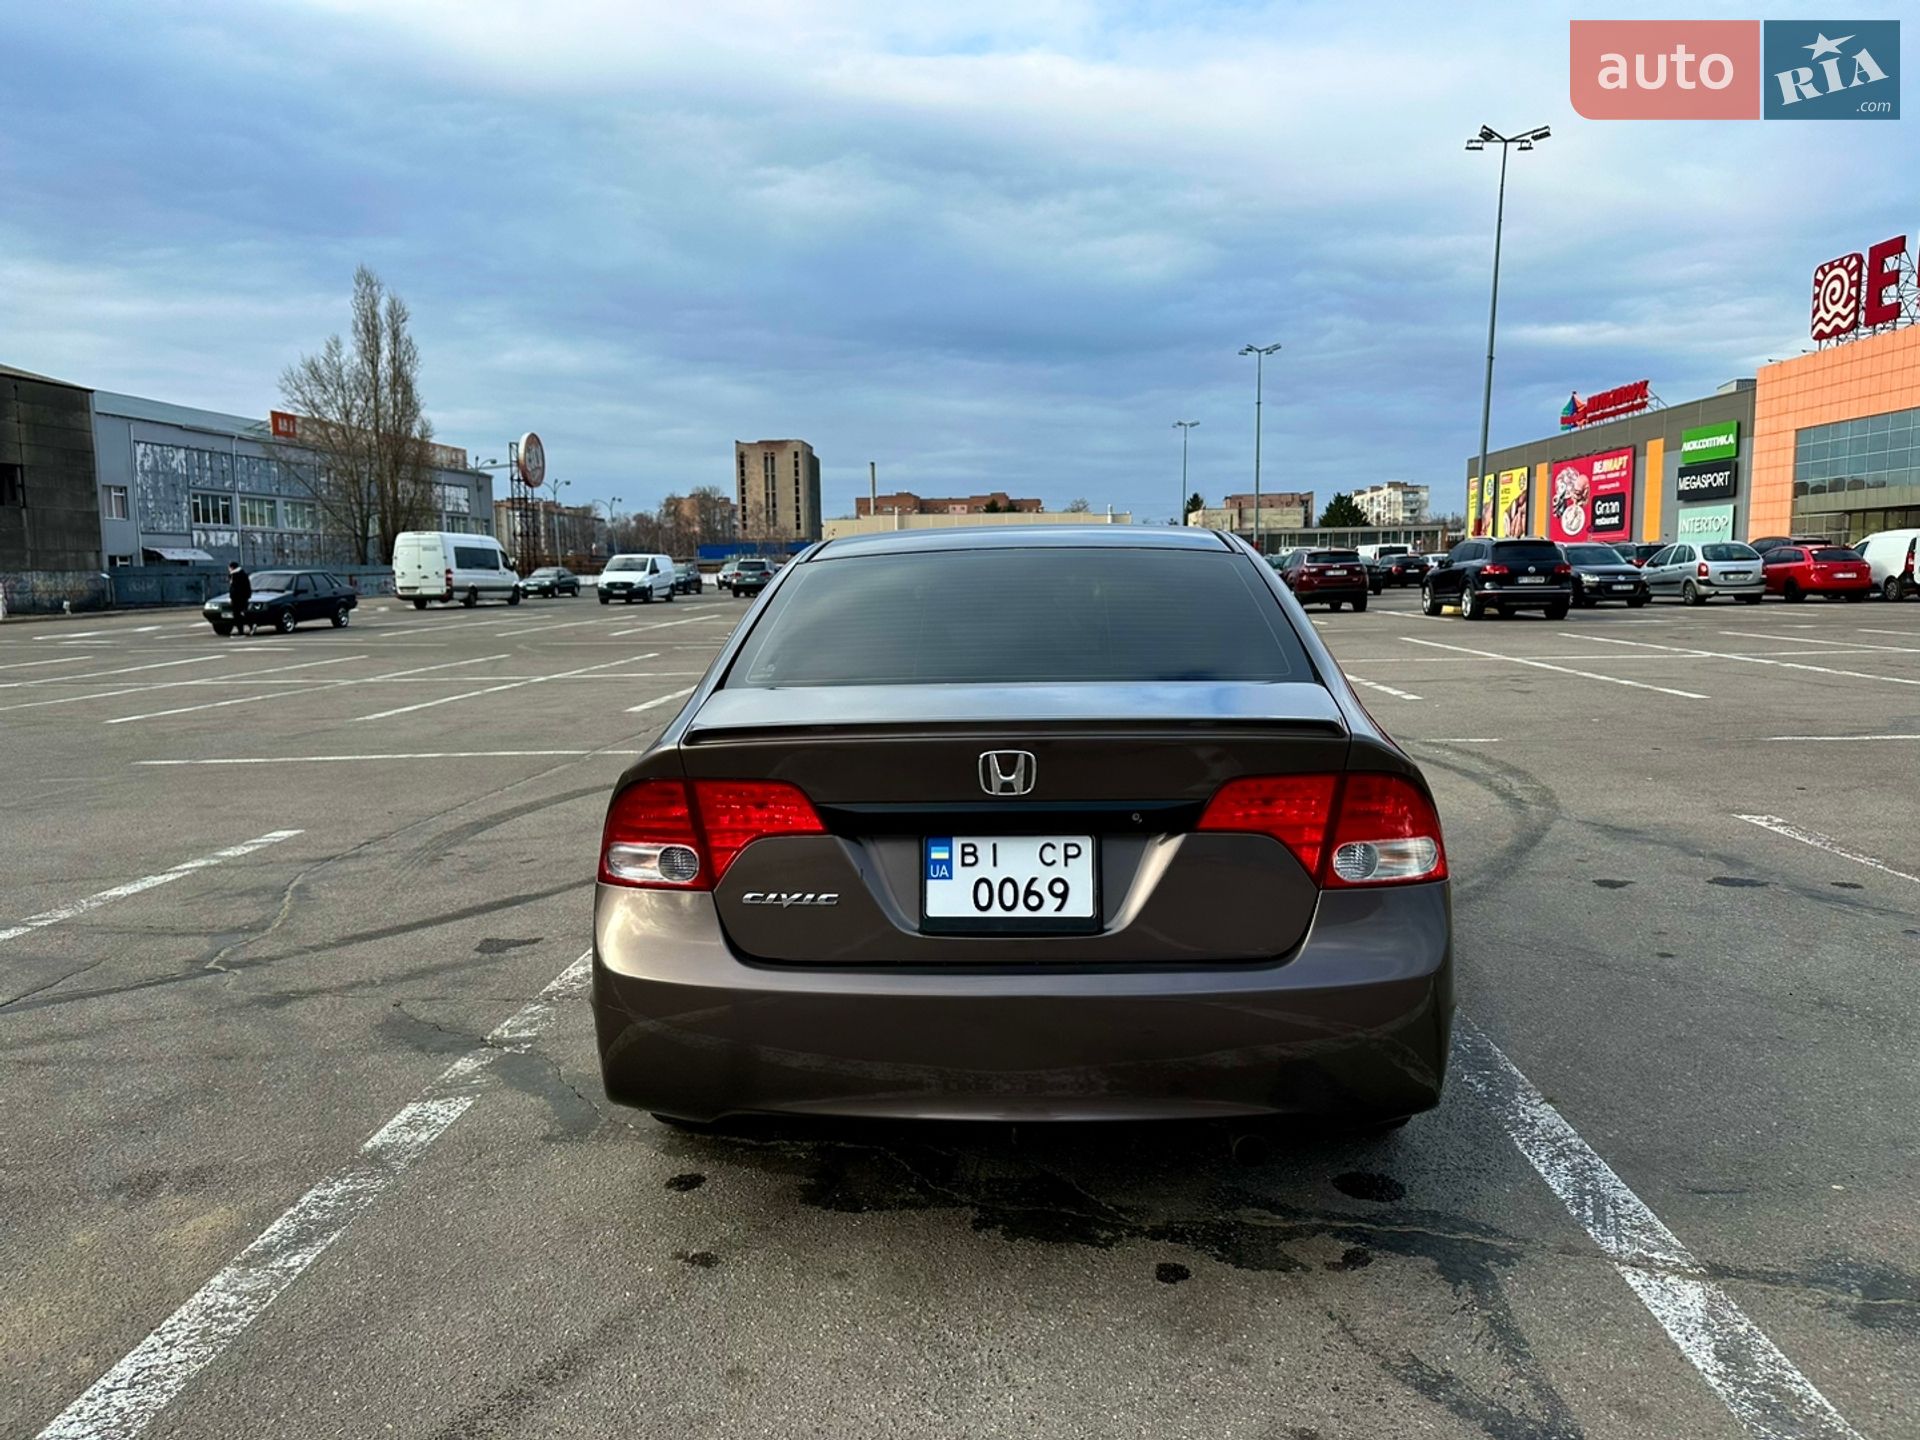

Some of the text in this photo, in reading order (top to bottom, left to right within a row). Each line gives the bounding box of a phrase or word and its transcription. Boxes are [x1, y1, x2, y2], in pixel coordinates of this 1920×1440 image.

[1678, 471, 1730, 491] MEGASPORT
[1679, 516, 1729, 533] INTERTOP
[1038, 842, 1083, 867] CP
[930, 865, 949, 878] UA
[742, 892, 840, 908] CIVIC
[972, 876, 1070, 913] 0069
